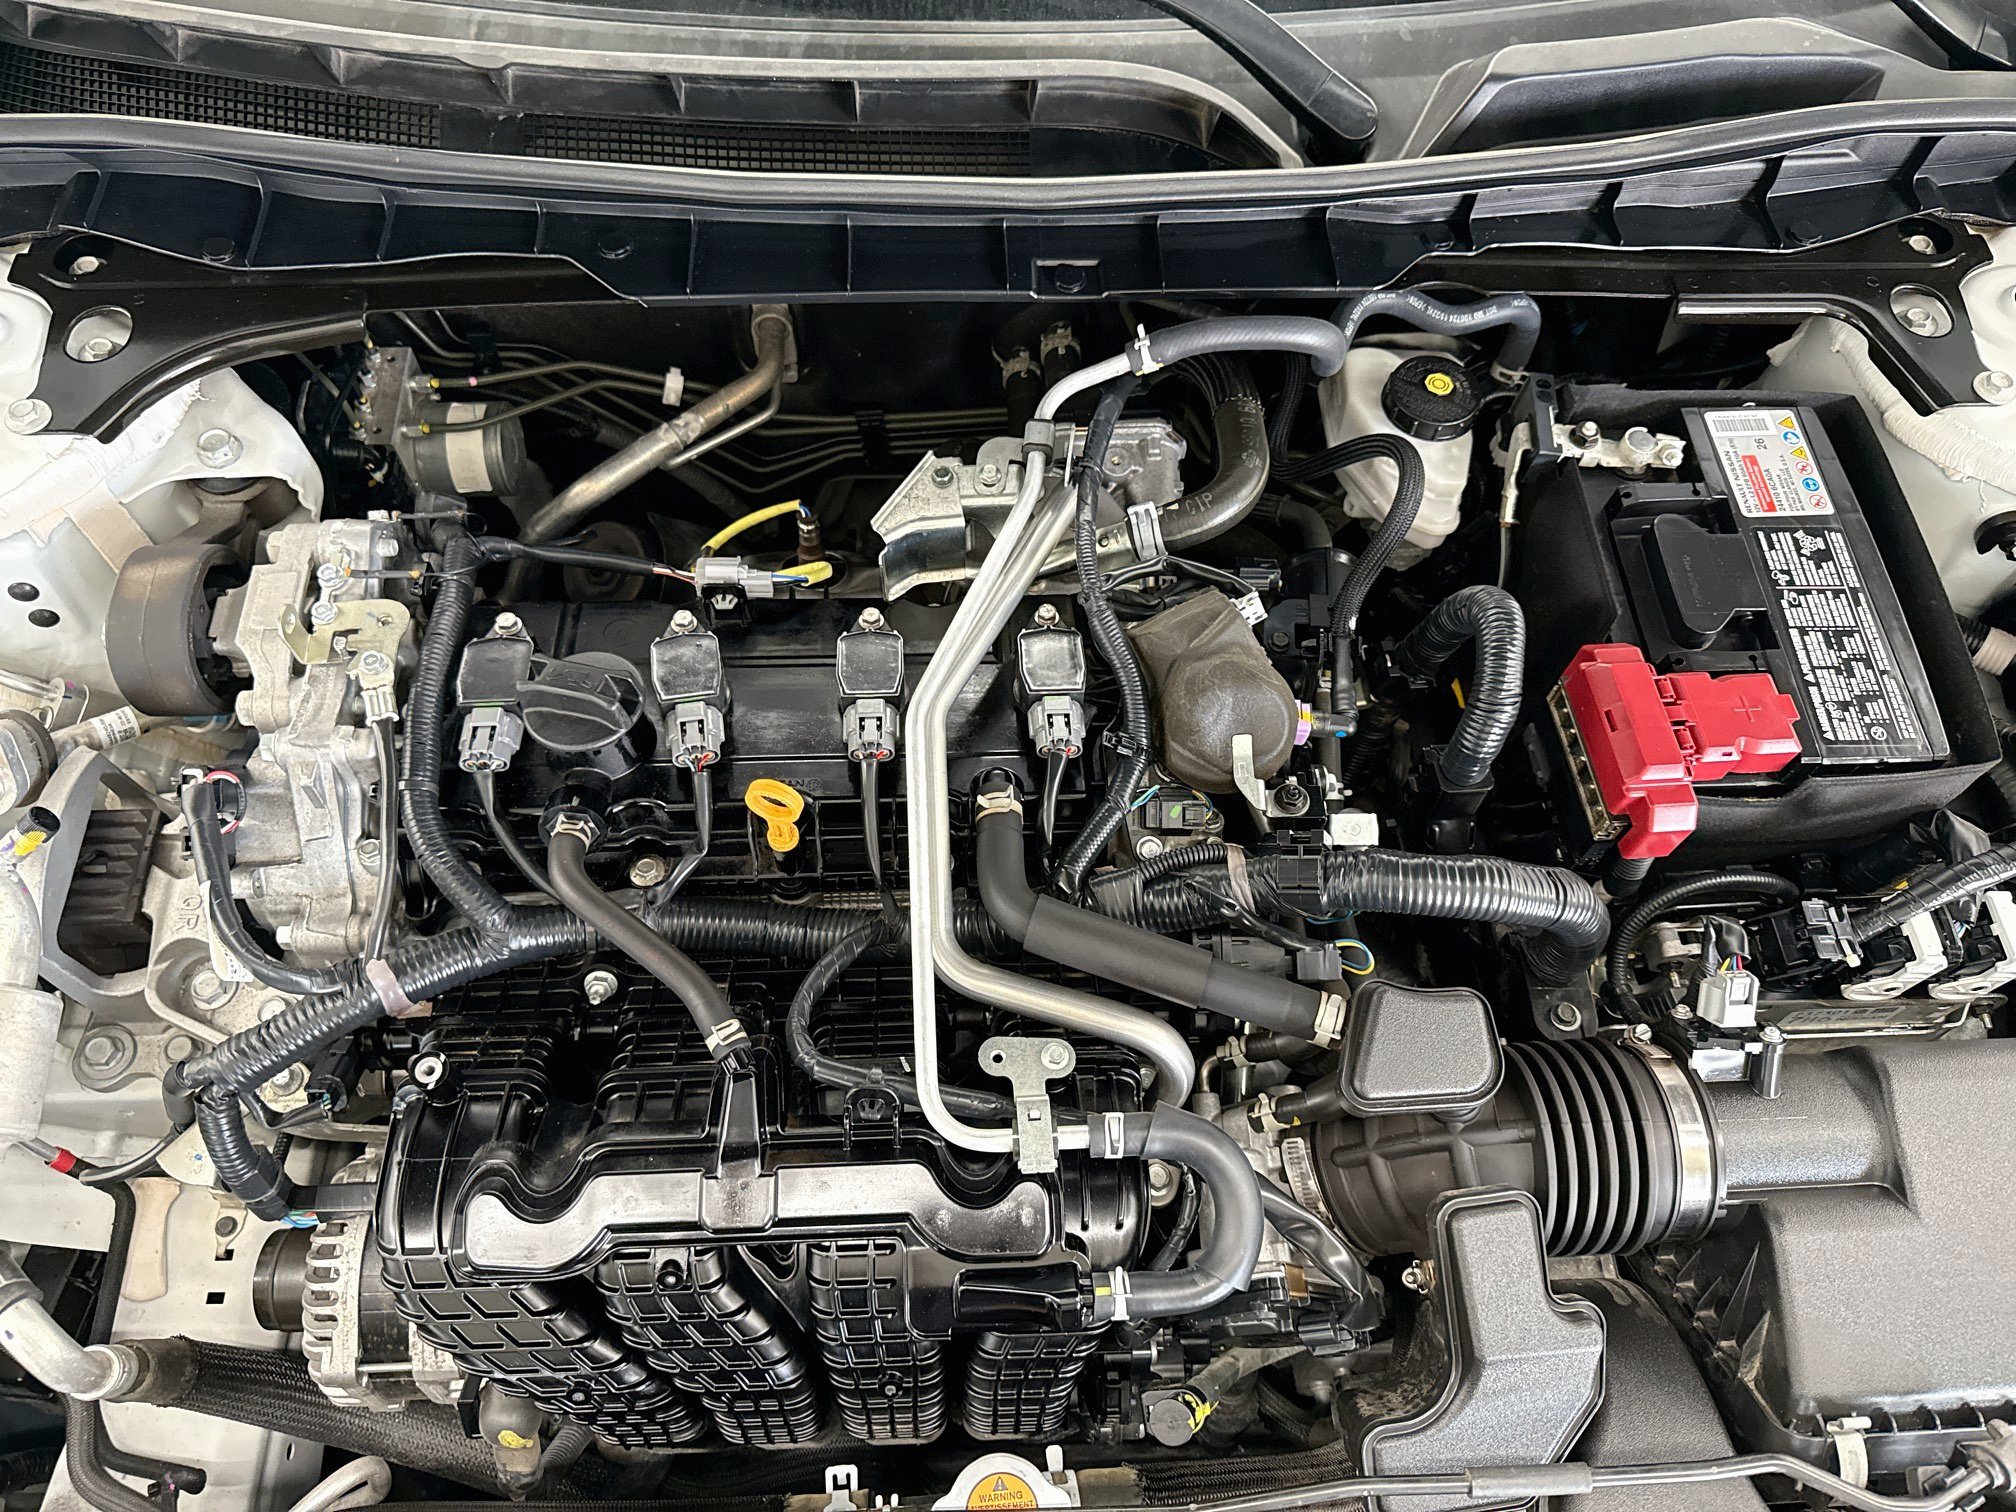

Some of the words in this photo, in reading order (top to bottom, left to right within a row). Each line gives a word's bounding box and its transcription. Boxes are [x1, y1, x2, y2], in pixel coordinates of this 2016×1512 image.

[1753, 437, 1768, 449] 26
[1722, 450, 1740, 480] NISSAN
[1735, 482, 1753, 513] RENAULT
[979, 1490, 1023, 1503] WARNING
